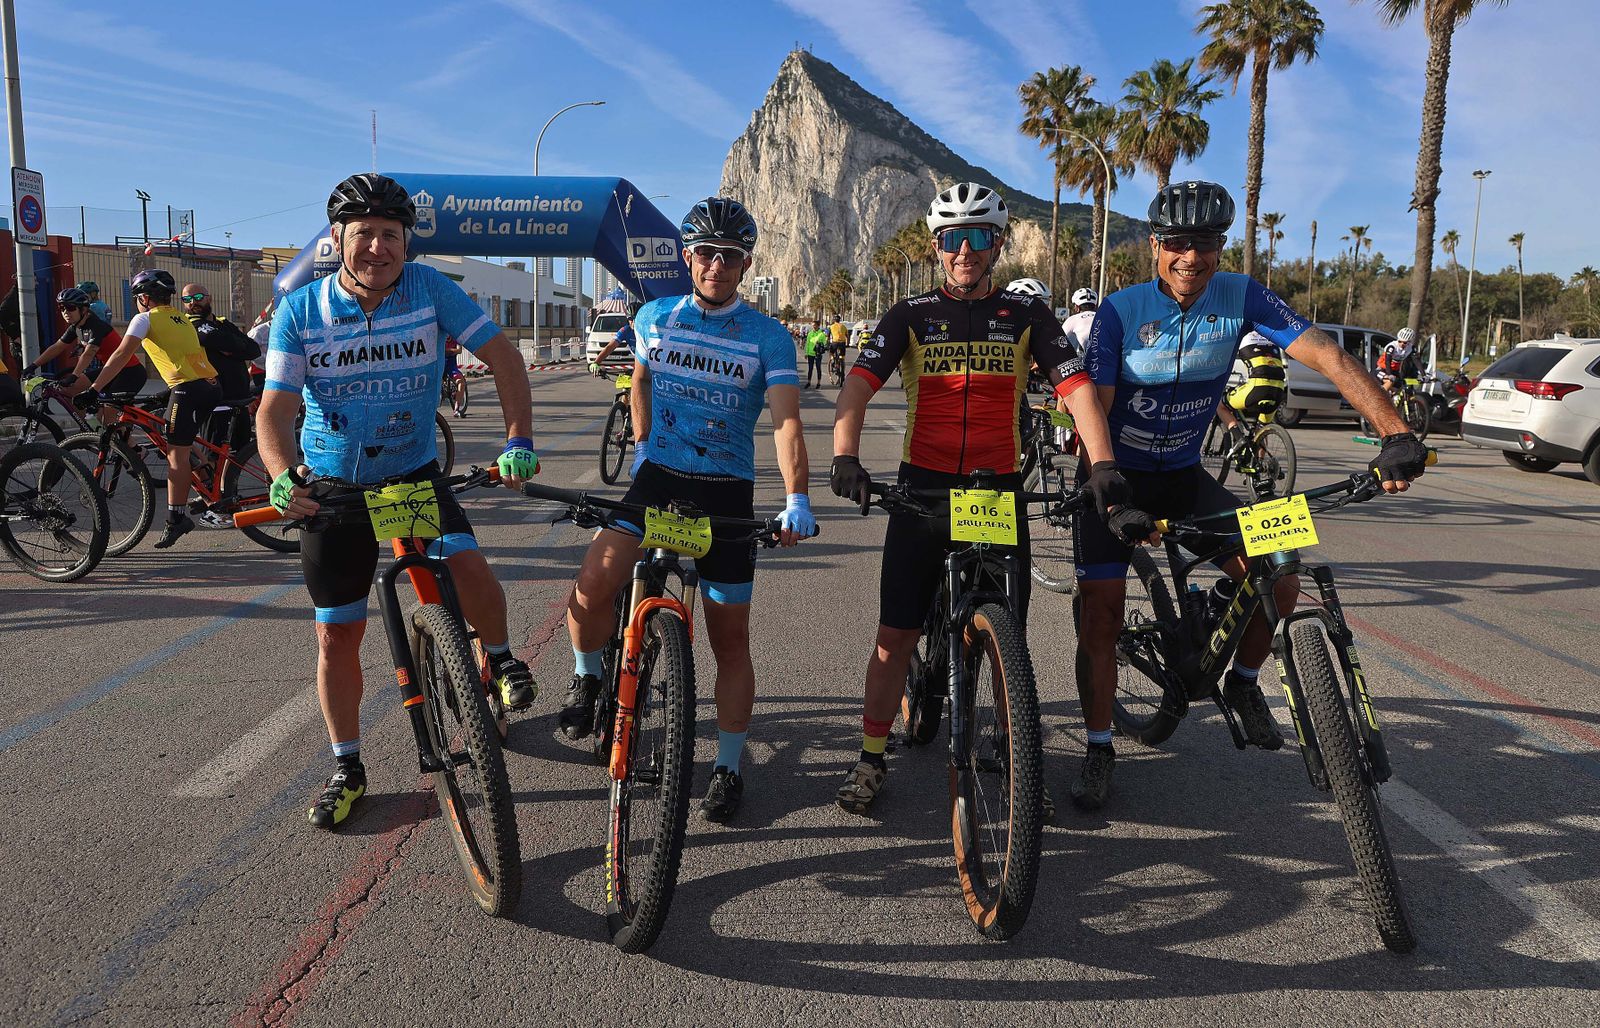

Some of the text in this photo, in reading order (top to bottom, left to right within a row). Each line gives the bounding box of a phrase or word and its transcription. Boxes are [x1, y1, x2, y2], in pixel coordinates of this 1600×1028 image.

[442, 194, 583, 216] Ayuntamiento
[459, 217, 569, 235] de La Línea
[630, 270, 680, 279] DEPORTES
[309, 338, 427, 368] CC MANILVA
[923, 344, 1015, 359] ANDALUCIA
[648, 347, 745, 380] CC MANILVA
[923, 358, 1015, 374] NATURE
[313, 373, 428, 397] Groman
[653, 373, 740, 408] Groman
[506, 451, 532, 464] CCR
[970, 504, 998, 516] 016
[1261, 514, 1292, 530] 026
